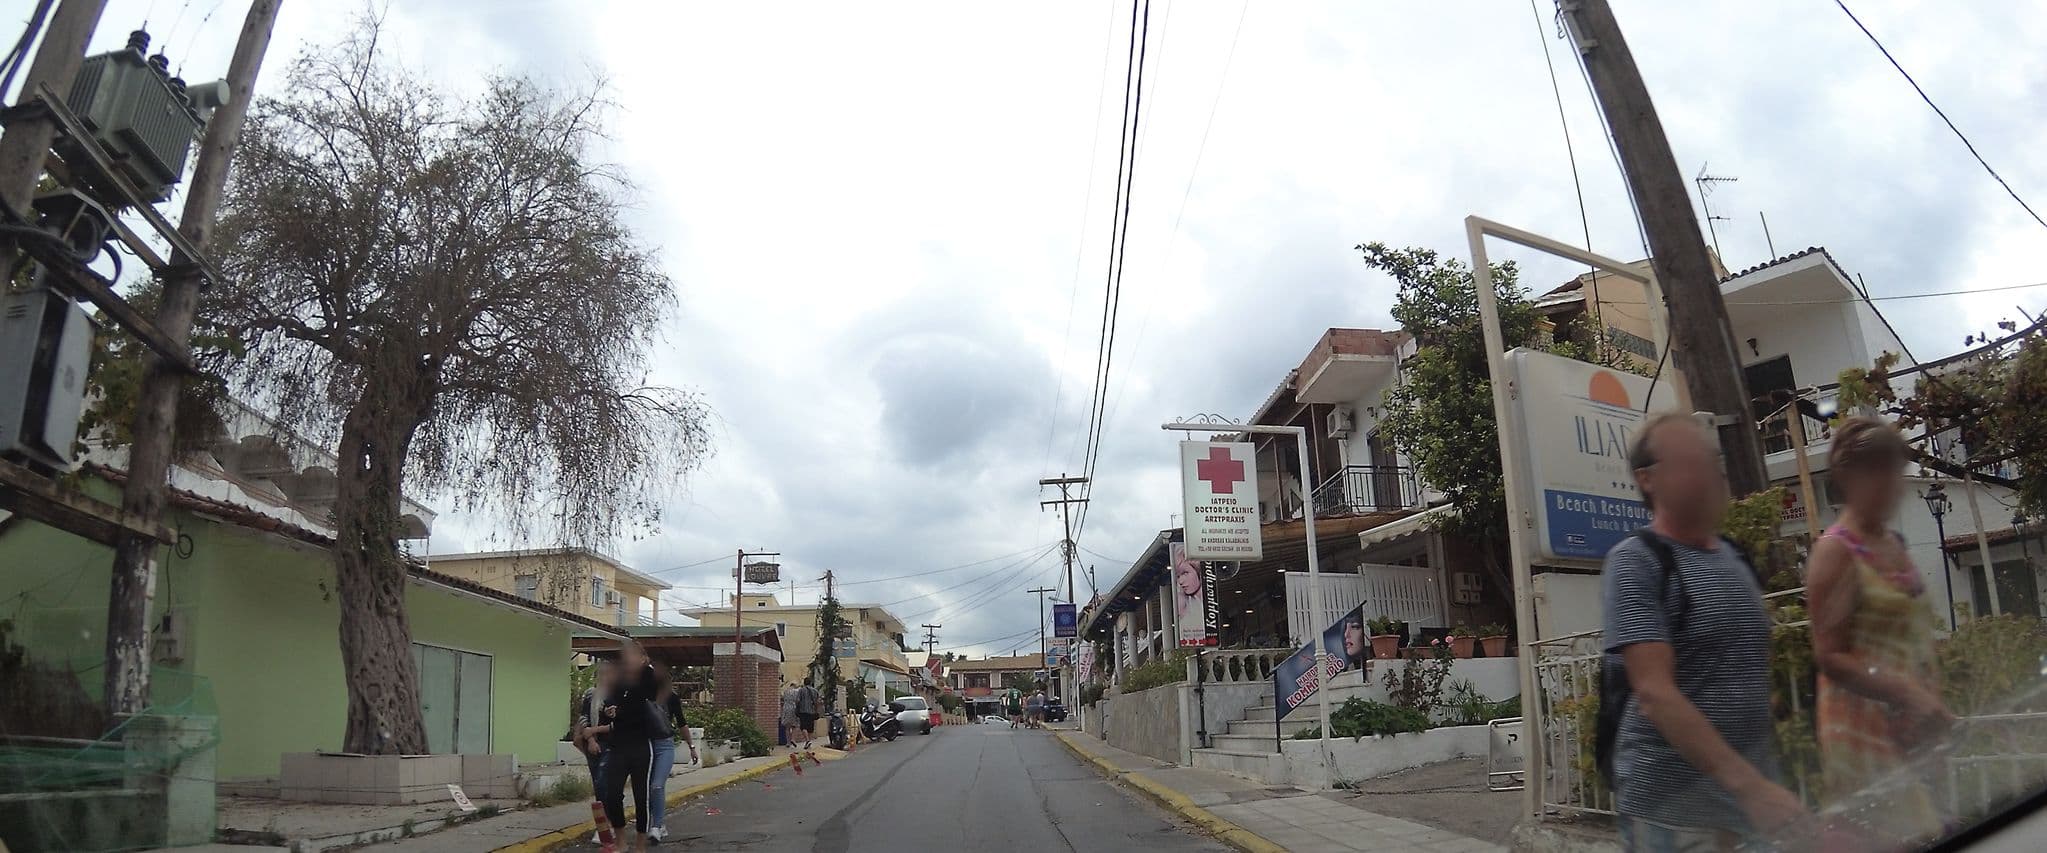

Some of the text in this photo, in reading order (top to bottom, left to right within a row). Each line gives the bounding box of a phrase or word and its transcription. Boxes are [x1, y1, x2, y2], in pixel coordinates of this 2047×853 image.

[1556, 494, 1654, 520] Beach Restaura
[1205, 515, 1245, 523] ARZTPRAXIS
[1592, 517, 1620, 530] Lunch
